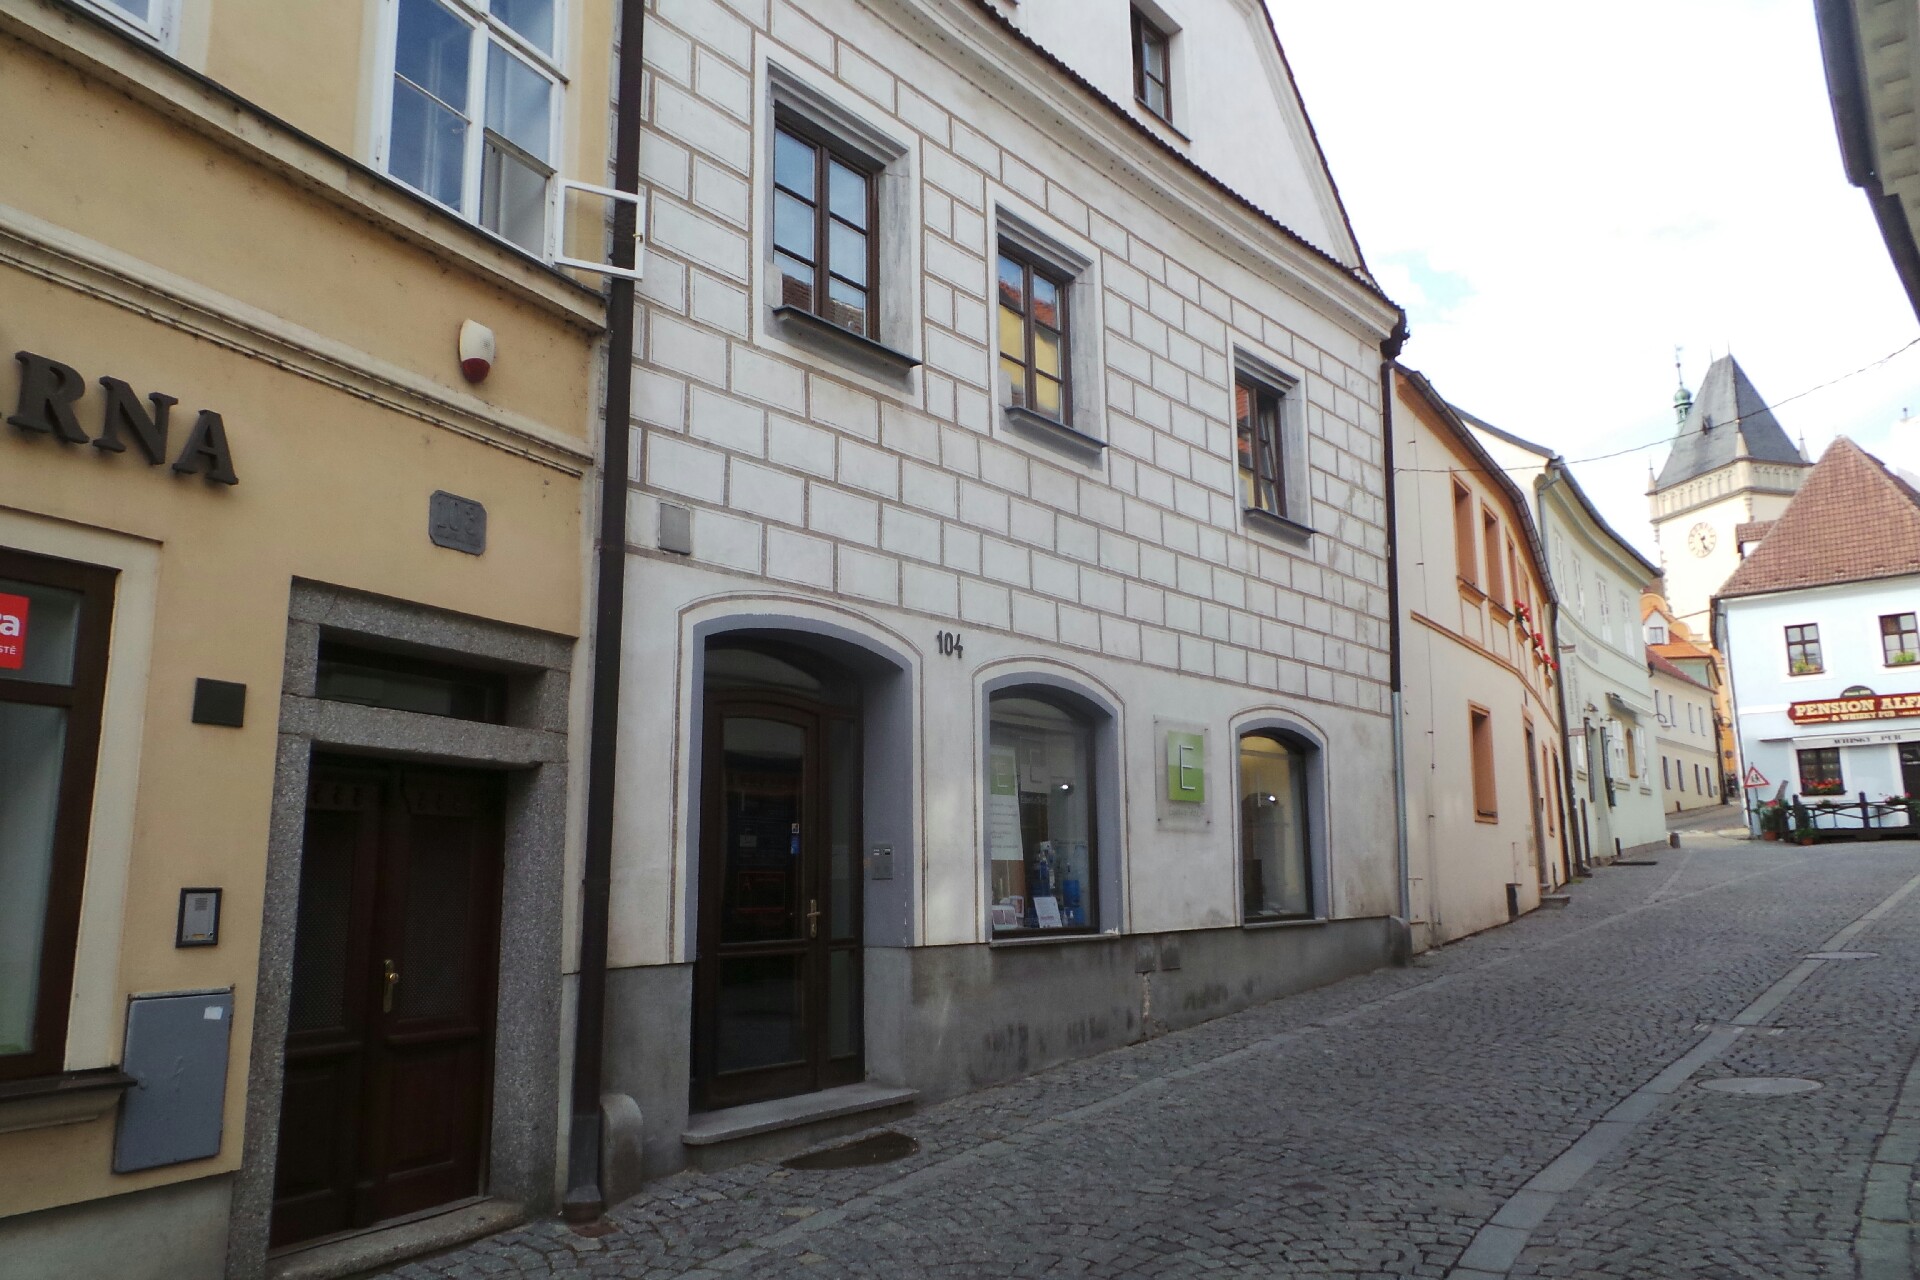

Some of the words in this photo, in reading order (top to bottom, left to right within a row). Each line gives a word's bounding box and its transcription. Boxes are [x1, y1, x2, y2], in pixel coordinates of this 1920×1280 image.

[0, 351, 239, 486] RNA
[0, 614, 20, 637] a
[936, 630, 964, 659] 104
[1795, 700, 1875, 716] PENSION
[1881, 696, 1920, 709] ALF
[1879, 710, 1896, 718] PUB
